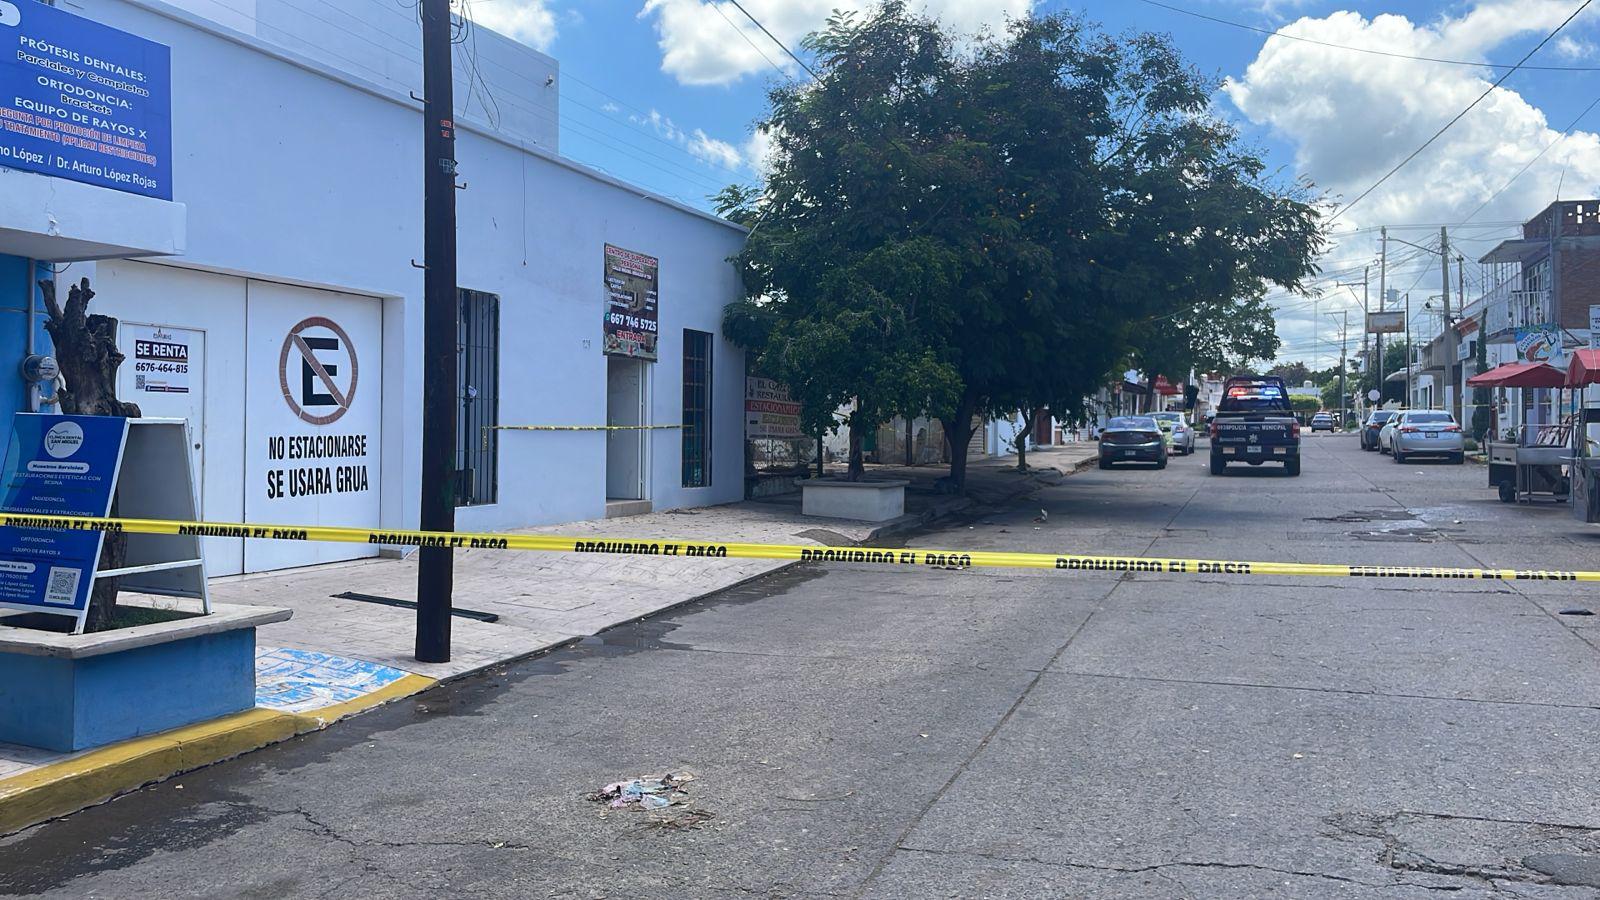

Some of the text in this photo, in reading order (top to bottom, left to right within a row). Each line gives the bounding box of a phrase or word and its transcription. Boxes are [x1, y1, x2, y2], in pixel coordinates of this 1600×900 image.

[20, 35, 147, 82] PRÓTESIS DENTALES:
[17, 50, 149, 97] Parciales y Completas
[37, 76, 133, 110] ORTODONCIA:
[61, 94, 112, 115] Brackets
[15, 97, 147, 139] EQUIPO DE RAYOS X
[35, 116, 53, 129] POR
[4, 120, 60, 142] TRATAMIENTO
[13, 146, 44, 164] López
[57, 156, 70, 169] Dr.
[72, 160, 101, 176] Arturo
[104, 166, 131, 183] López
[132, 173, 157, 188] Rojas
[611, 313, 624, 325] 667
[640, 319, 657, 331] 5725
[137, 342, 187, 357] SE RENTA
[136, 362, 188, 373] 6676-464-815
[268, 435, 367, 459] NO ESTACIONARSE
[267, 465, 369, 499] SE USARA GRUA
